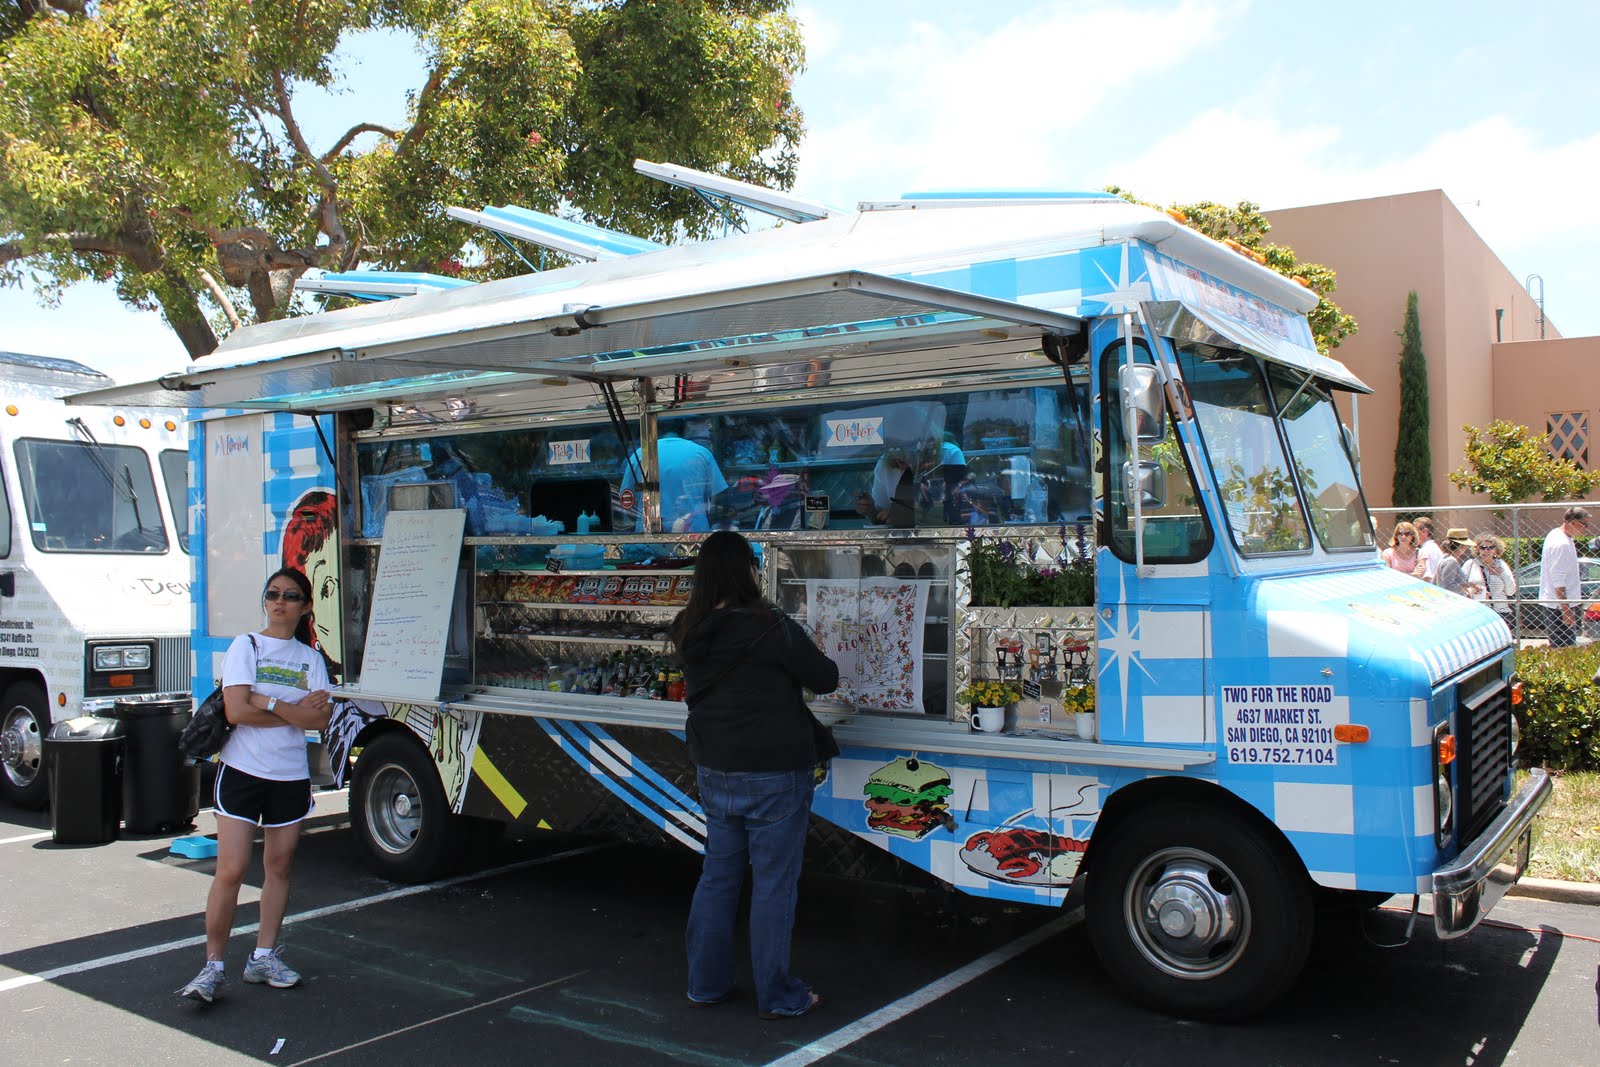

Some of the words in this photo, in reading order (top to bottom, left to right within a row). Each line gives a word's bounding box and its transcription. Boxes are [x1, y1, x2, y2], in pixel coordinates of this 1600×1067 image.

[835, 422, 875, 442] Order
[219, 434, 246, 456] Menu
[837, 622, 889, 652] FLORIDA
[1224, 687, 1248, 703] TWO
[1251, 687, 1273, 703] FOR
[1276, 687, 1298, 703] THE
[1301, 687, 1332, 703] ROAD
[1237, 708, 1261, 724] 4637
[1264, 708, 1305, 724] MARKET
[1307, 709, 1322, 725] ST.
[1227, 727, 1247, 743] SAN
[1249, 727, 1283, 745] DIEGO,
[1285, 728, 1299, 743] CA
[1301, 728, 1333, 744] 92101
[1230, 747, 1334, 764] 619.752.7104
